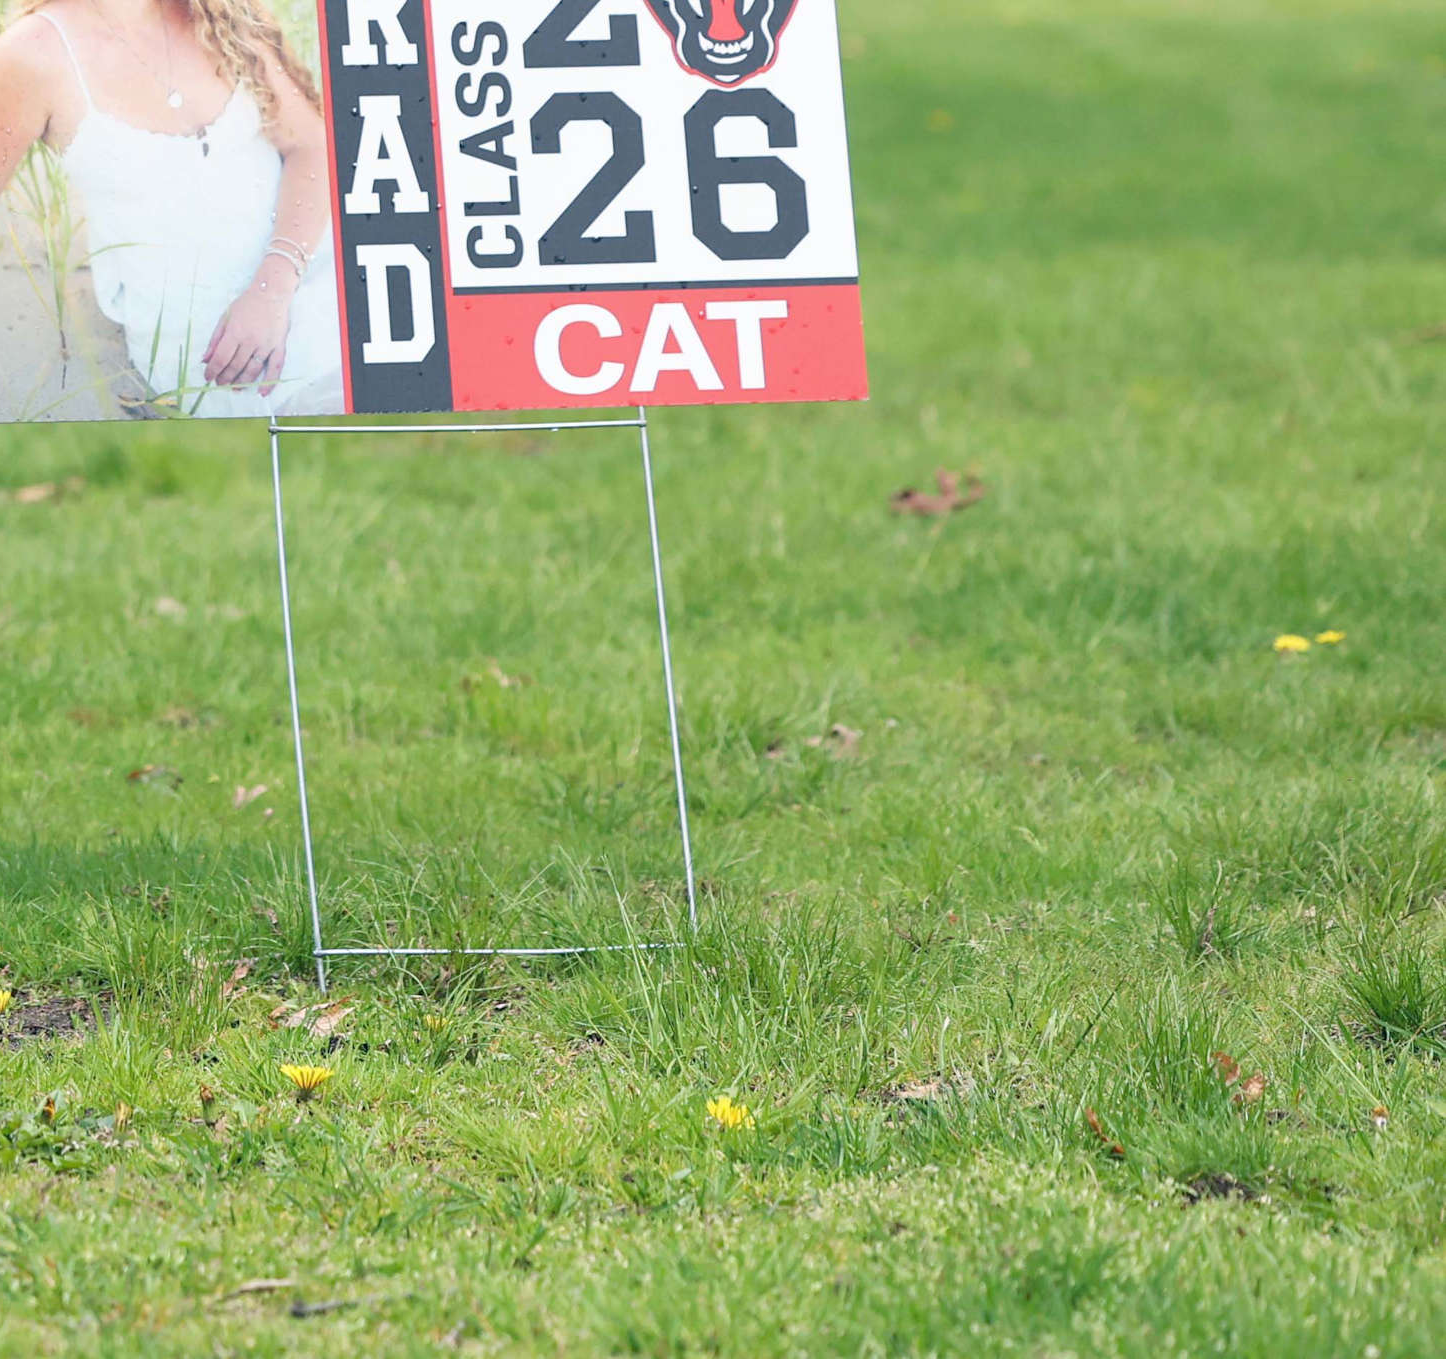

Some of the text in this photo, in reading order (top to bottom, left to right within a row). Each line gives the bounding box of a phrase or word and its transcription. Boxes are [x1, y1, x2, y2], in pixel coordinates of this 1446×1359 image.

[450, 20, 524, 269] CLASS
[529, 87, 810, 267] 26
[533, 298, 789, 395] CAT
